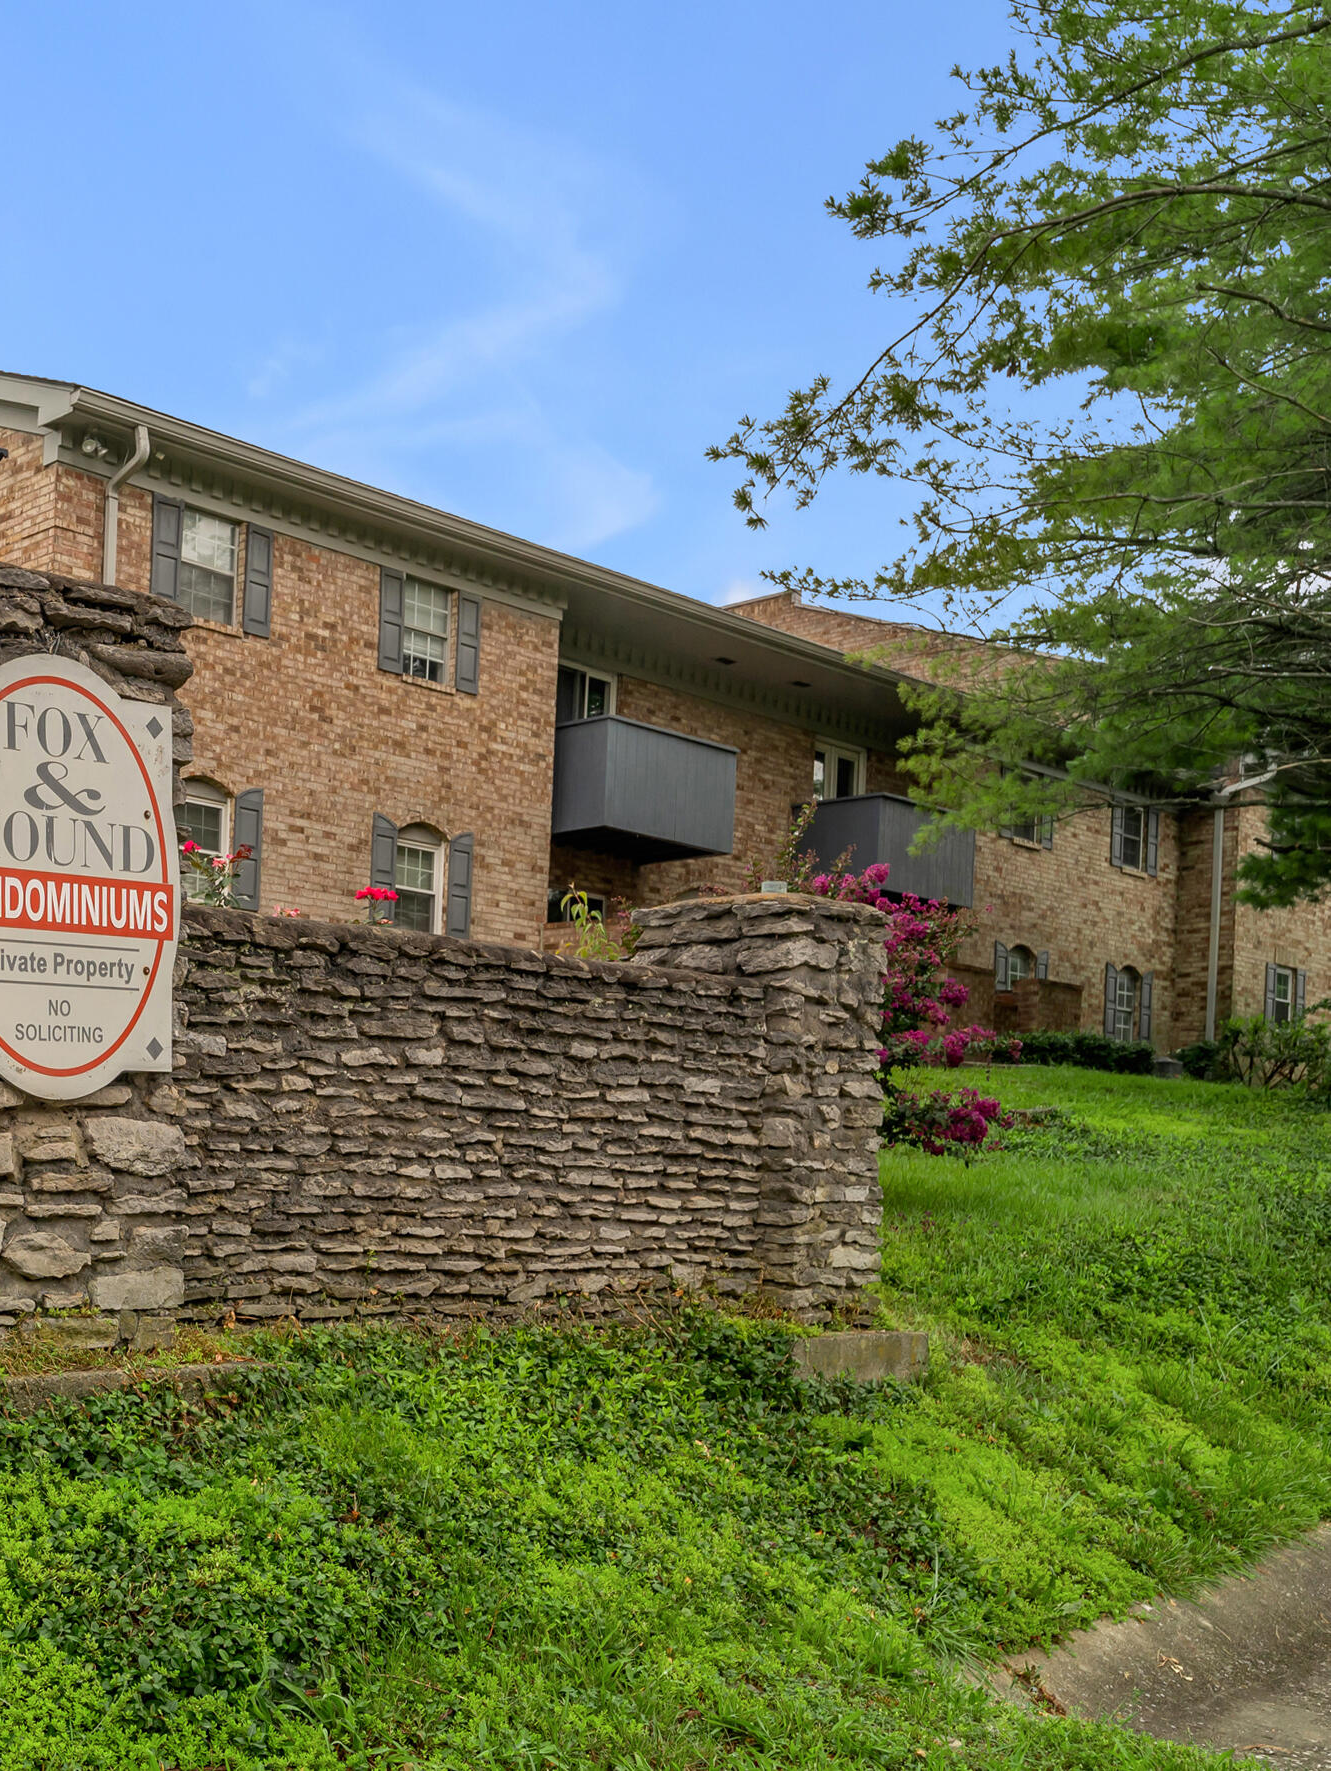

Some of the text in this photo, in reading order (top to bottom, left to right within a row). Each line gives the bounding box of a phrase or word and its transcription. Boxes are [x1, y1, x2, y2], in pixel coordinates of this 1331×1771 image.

[3, 699, 110, 765] FOX
[23, 761, 106, 816] &
[53, 952, 135, 985] Property
[48, 999, 71, 1017] NO
[15, 1023, 104, 1044] SOLICITING
